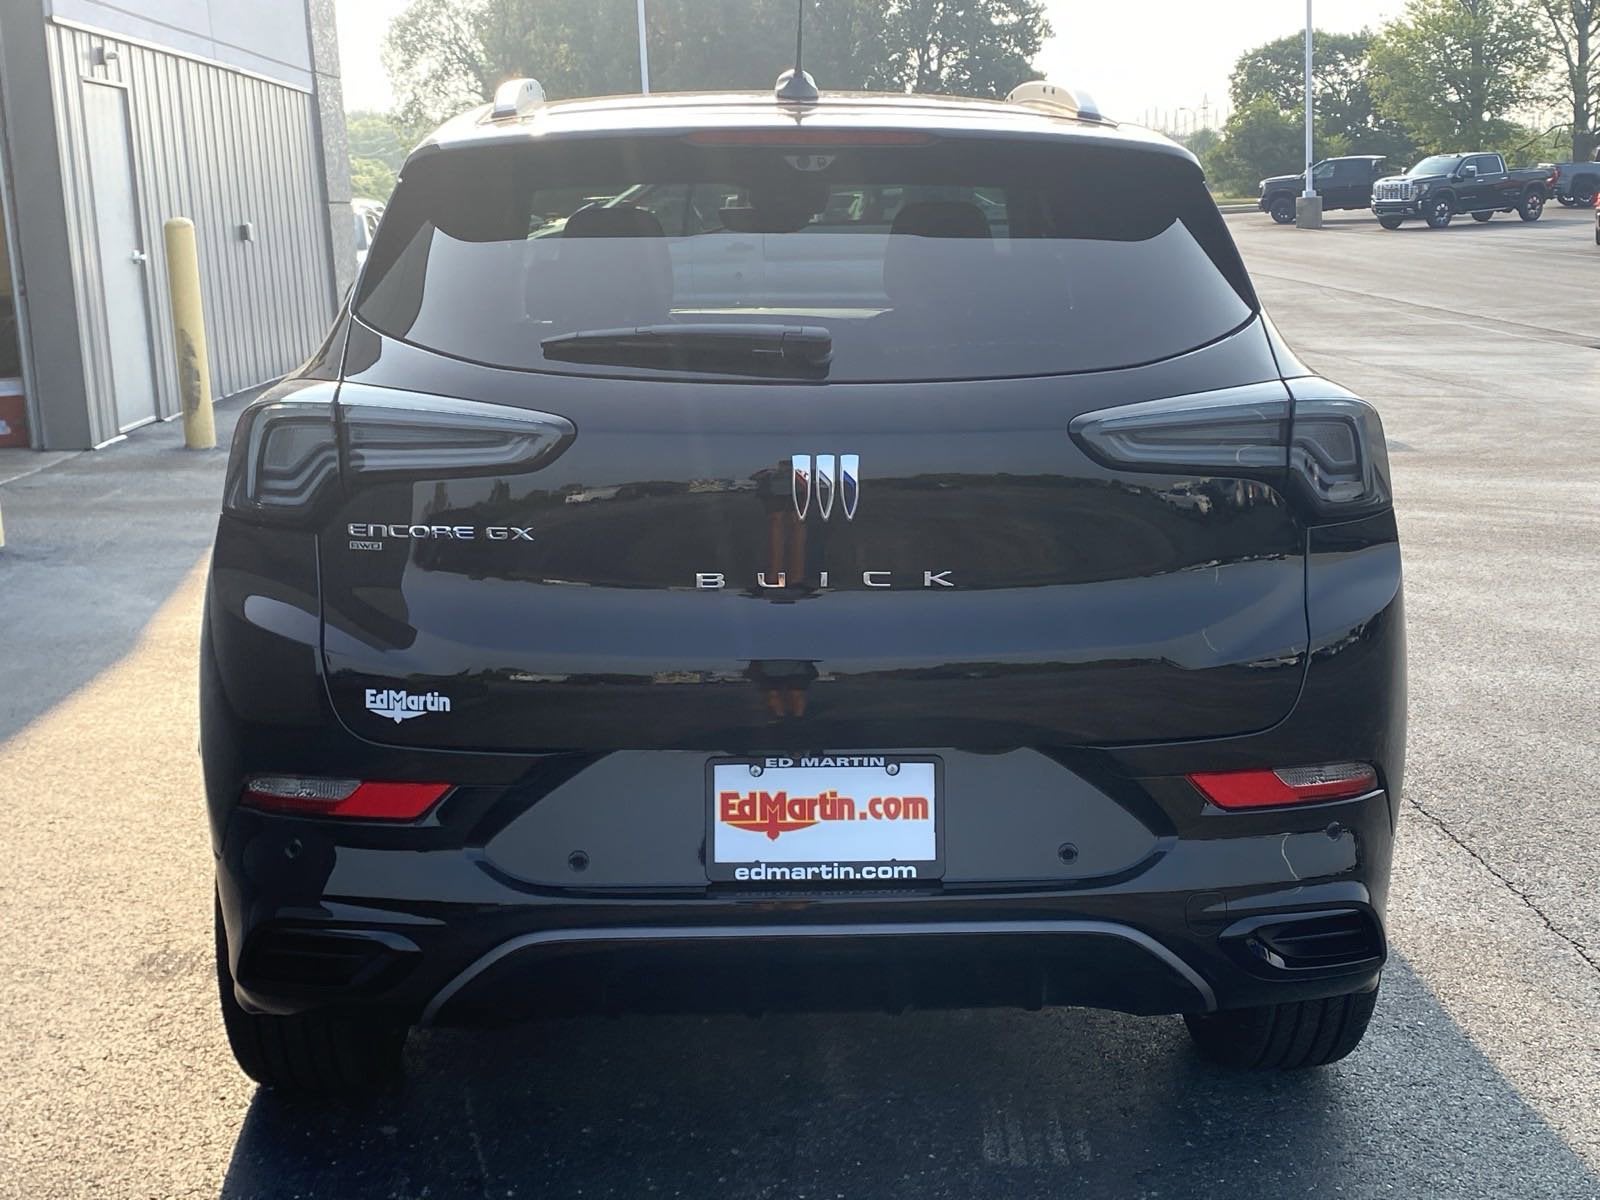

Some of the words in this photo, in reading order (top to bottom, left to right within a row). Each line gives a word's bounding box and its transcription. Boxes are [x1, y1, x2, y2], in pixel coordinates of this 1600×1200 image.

[348, 523, 475, 539] ENCORE
[486, 526, 535, 541] GX
[695, 571, 954, 588] BUICK
[365, 689, 451, 713] EdMartin
[765, 757, 794, 768] ED
[800, 757, 885, 768] MARTIN
[719, 790, 929, 822] EdMartin.com
[735, 863, 917, 880] edmartin.com
